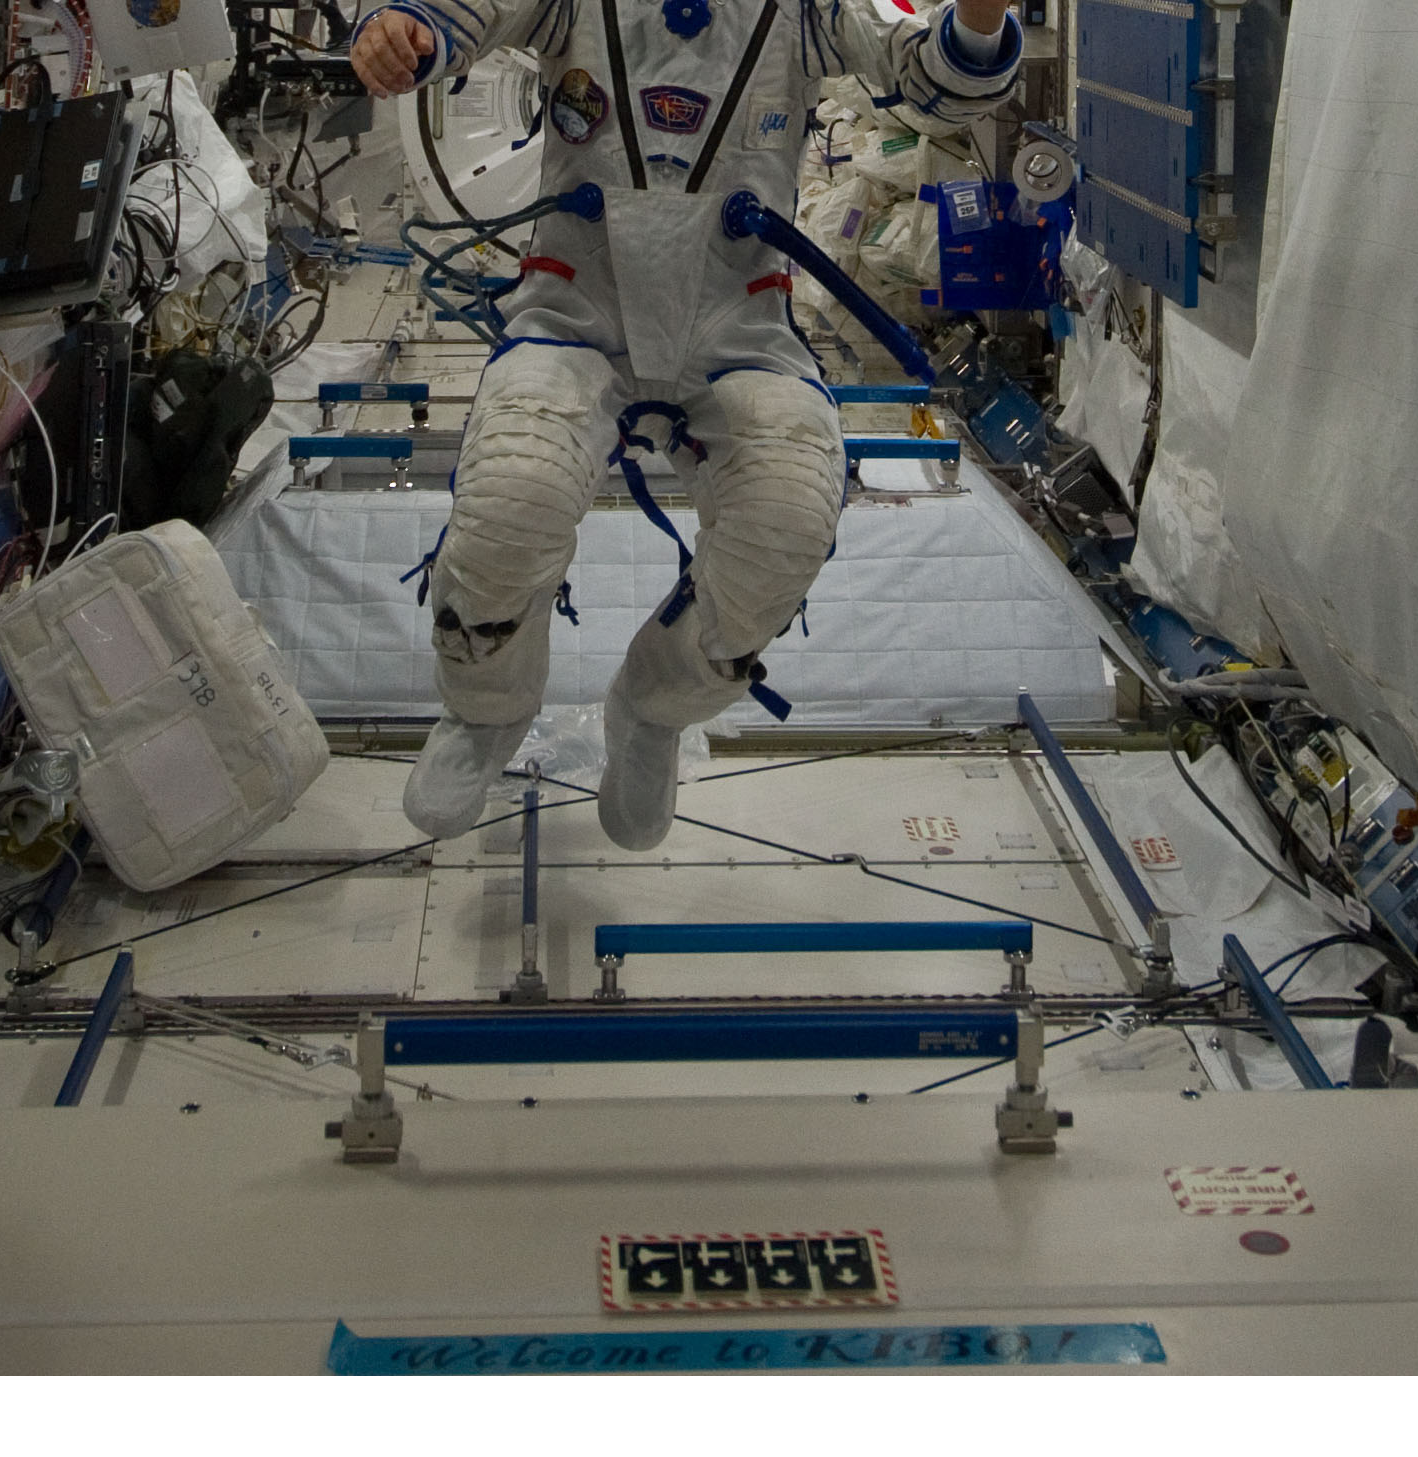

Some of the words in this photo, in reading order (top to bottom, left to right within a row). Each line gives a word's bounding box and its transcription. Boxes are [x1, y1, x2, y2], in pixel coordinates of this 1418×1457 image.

[257, 672, 290, 716] 1398
[391, 1337, 682, 1369] Welcome
[712, 1337, 769, 1364] to
